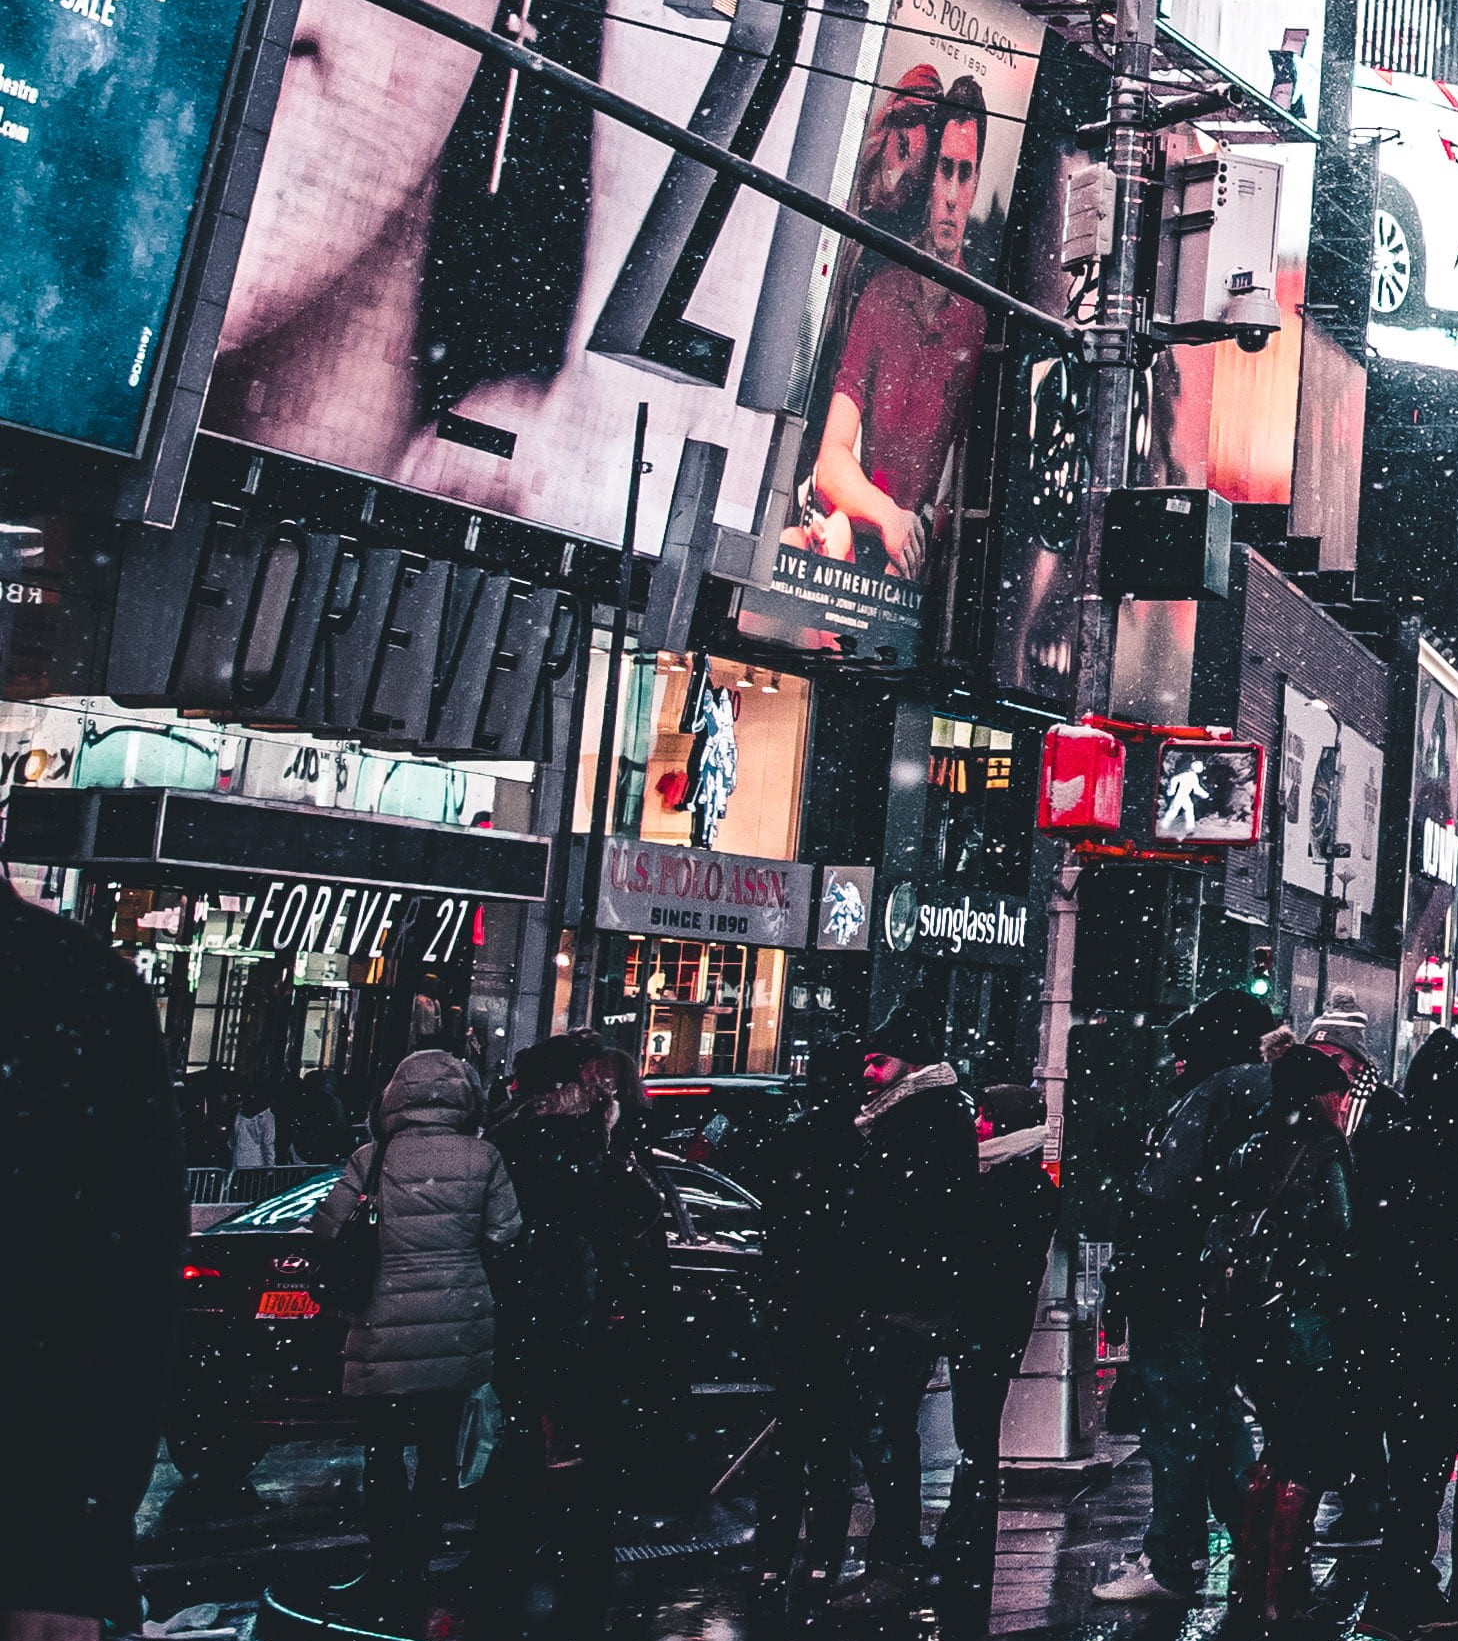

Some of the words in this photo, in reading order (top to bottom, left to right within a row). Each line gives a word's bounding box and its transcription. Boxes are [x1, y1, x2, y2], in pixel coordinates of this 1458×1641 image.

[941, 0, 979, 42] POLO
[773, 553, 807, 579] IVE
[813, 565, 923, 609] AUTHENTICALLY
[611, 847, 652, 893] U.S.
[422, 898, 469, 962] 21
[651, 907, 702, 930] SINCE
[709, 914, 748, 934] 1890
[919, 895, 996, 953] sunglass
[997, 900, 1028, 948] hut
